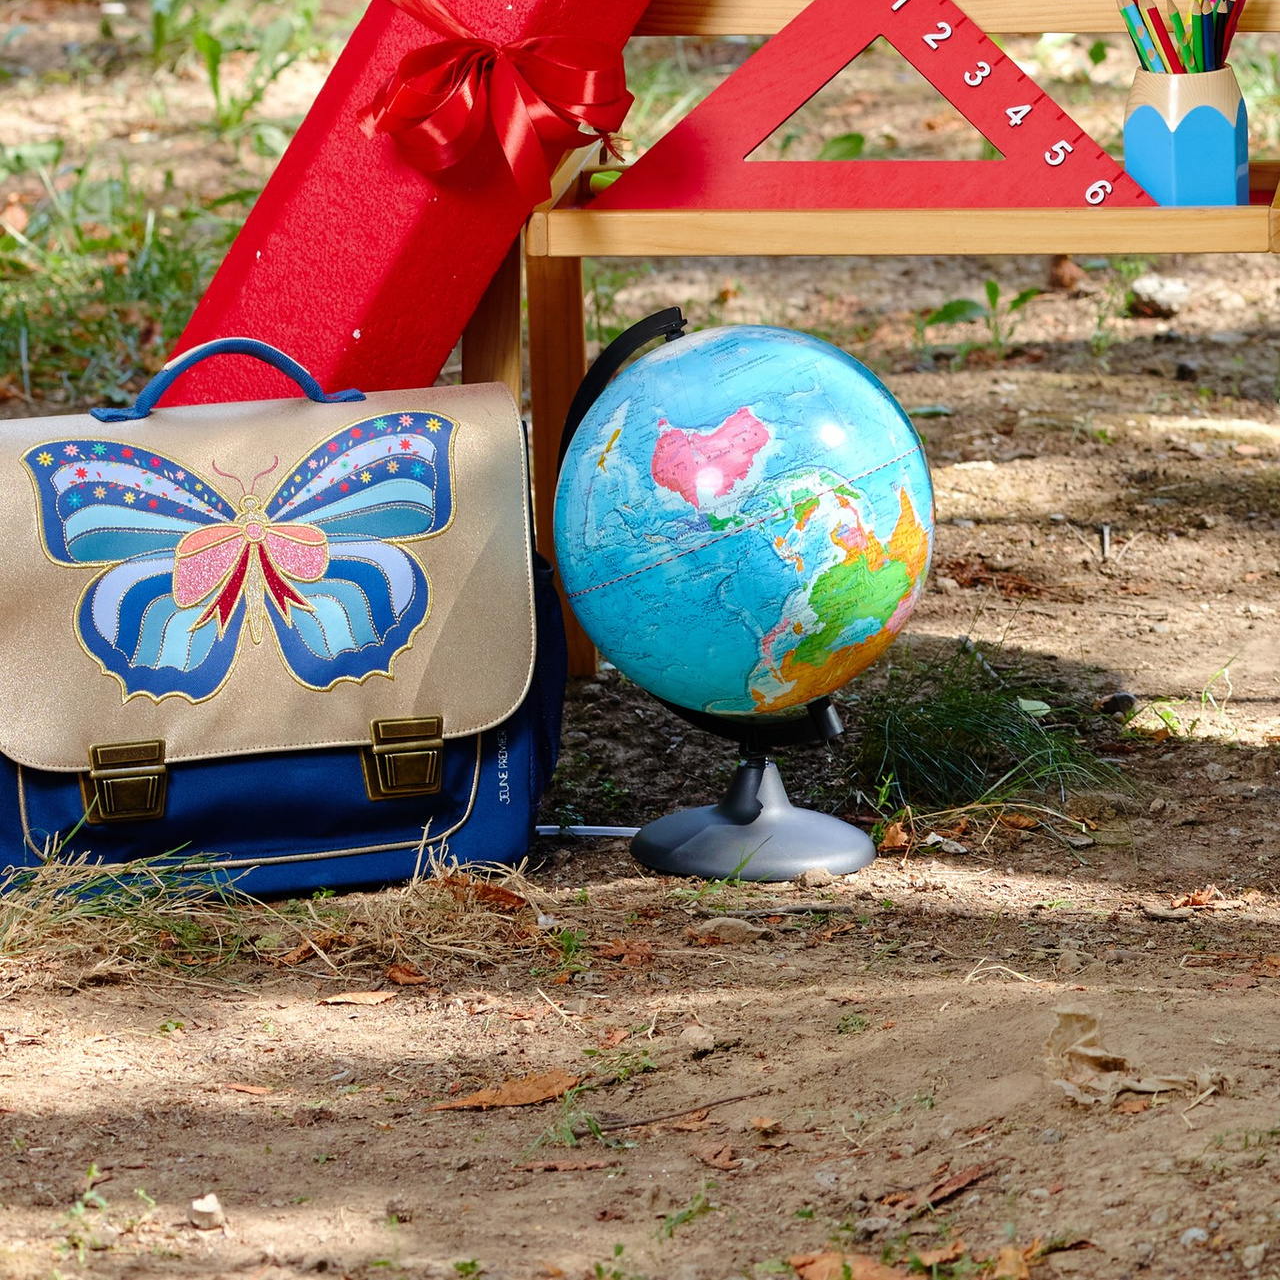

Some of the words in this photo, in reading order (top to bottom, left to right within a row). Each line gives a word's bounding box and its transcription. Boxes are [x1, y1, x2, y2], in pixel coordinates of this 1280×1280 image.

[922, 21, 953, 50] 2
[963, 60, 992, 87] 3
[1005, 103, 1033, 127] 4
[1044, 139, 1074, 166] 5
[1084, 179, 1113, 205] 6
[498, 770, 511, 805] JEUNE
